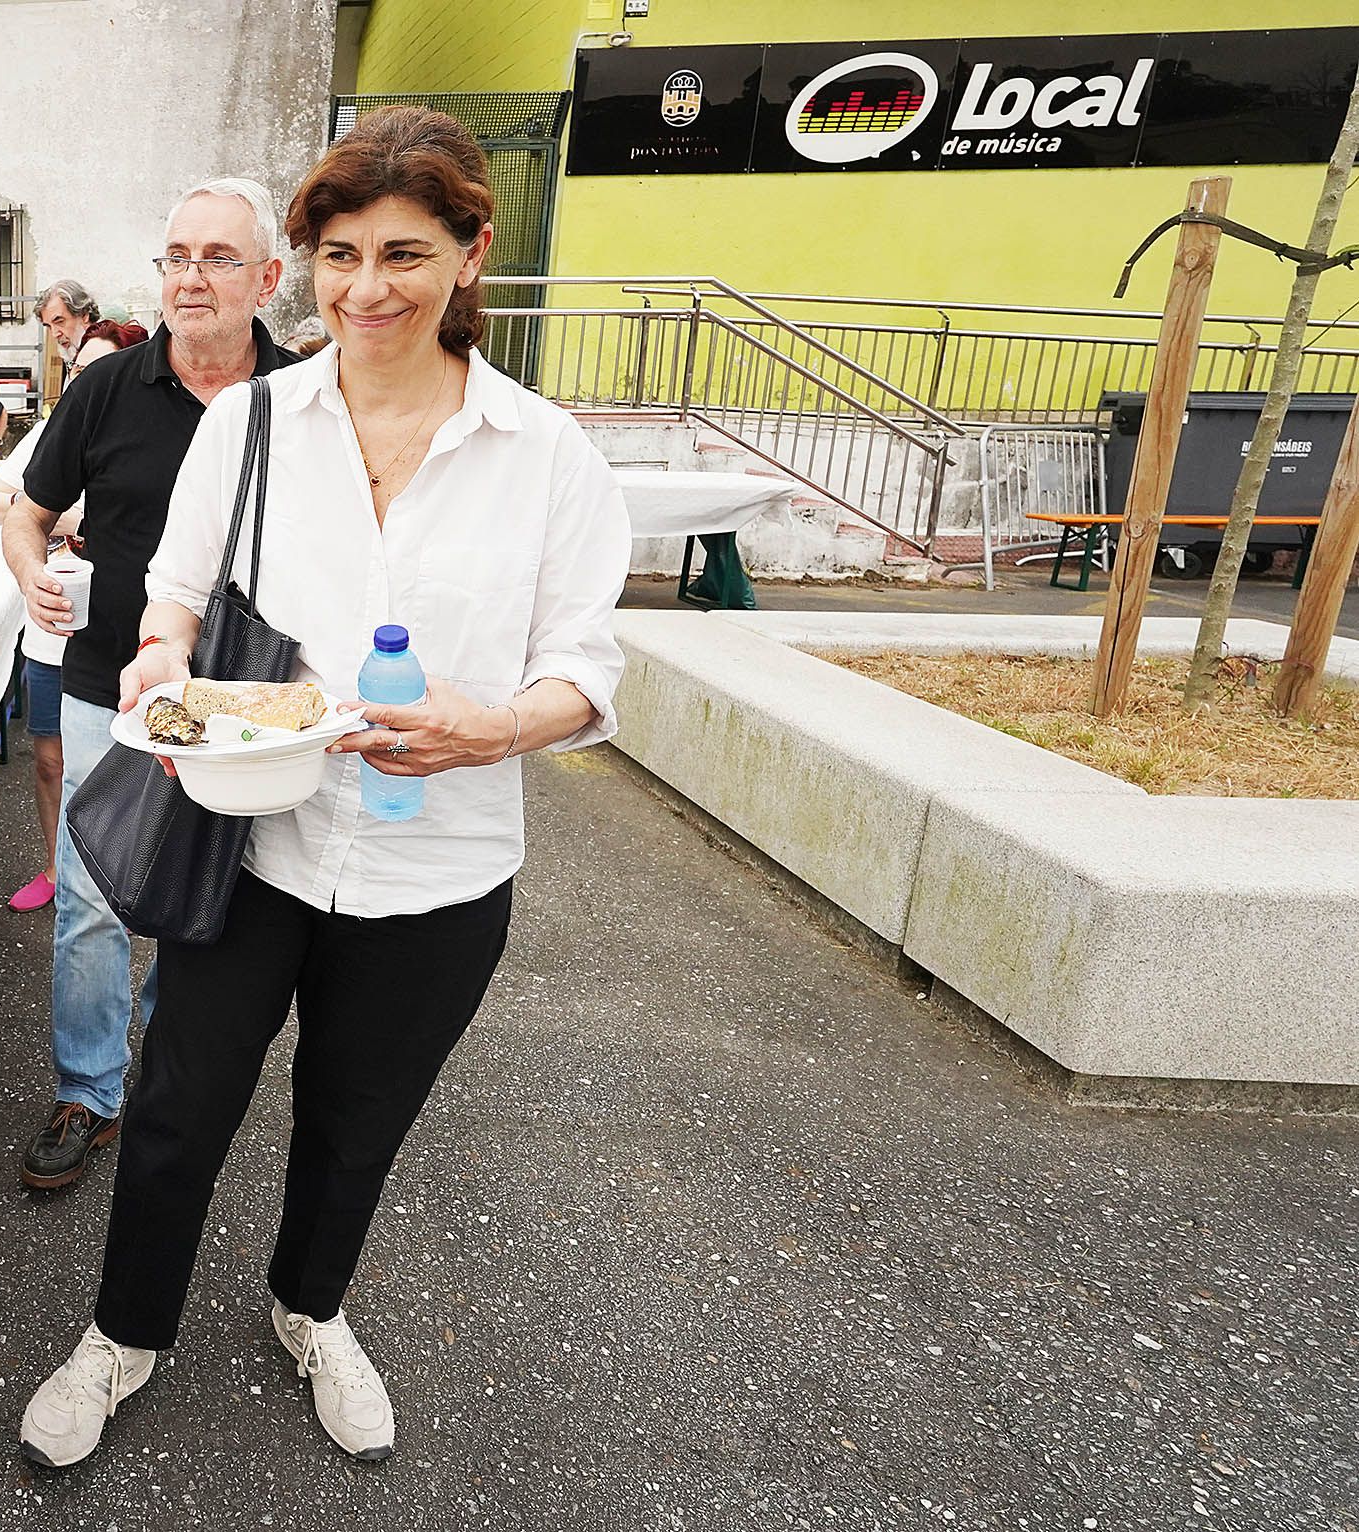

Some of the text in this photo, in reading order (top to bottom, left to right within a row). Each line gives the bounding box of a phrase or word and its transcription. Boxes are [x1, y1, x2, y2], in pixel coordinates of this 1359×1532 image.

[950, 58, 1154, 131] Local
[942, 132, 1063, 156] de música
[1241, 439, 1312, 452] RNSÁBEIS
